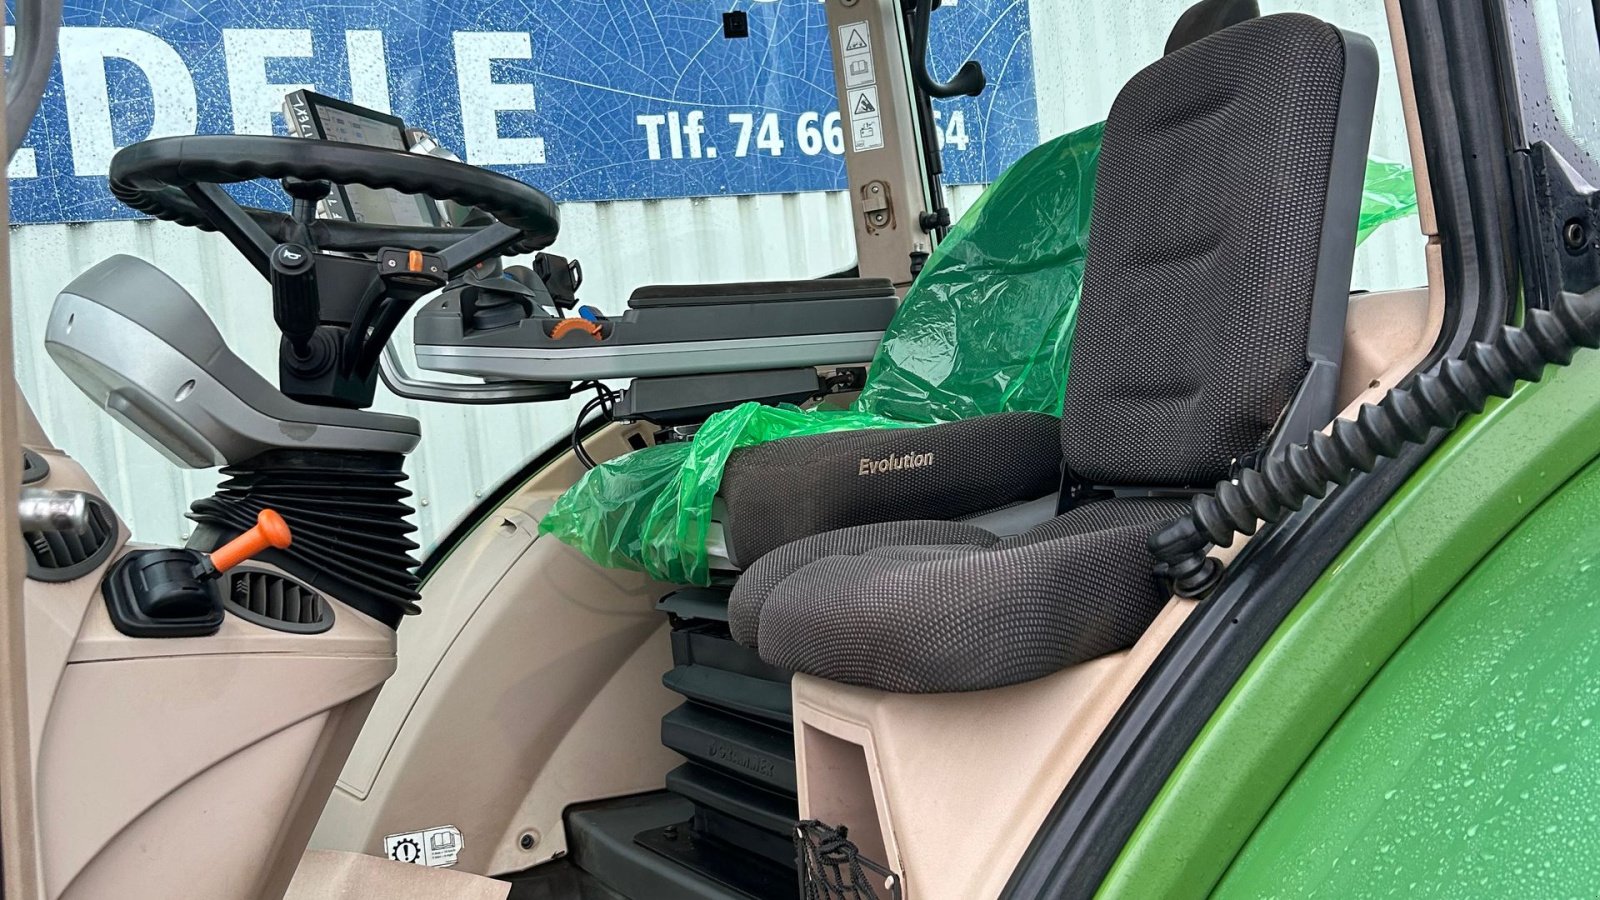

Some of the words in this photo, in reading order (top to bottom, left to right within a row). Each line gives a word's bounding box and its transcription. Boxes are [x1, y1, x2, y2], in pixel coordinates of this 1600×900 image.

[637, 111, 717, 160] Tlf.
[728, 113, 784, 157] 74
[797, 111, 845, 155] 66
[859, 451, 934, 475] Evolution
